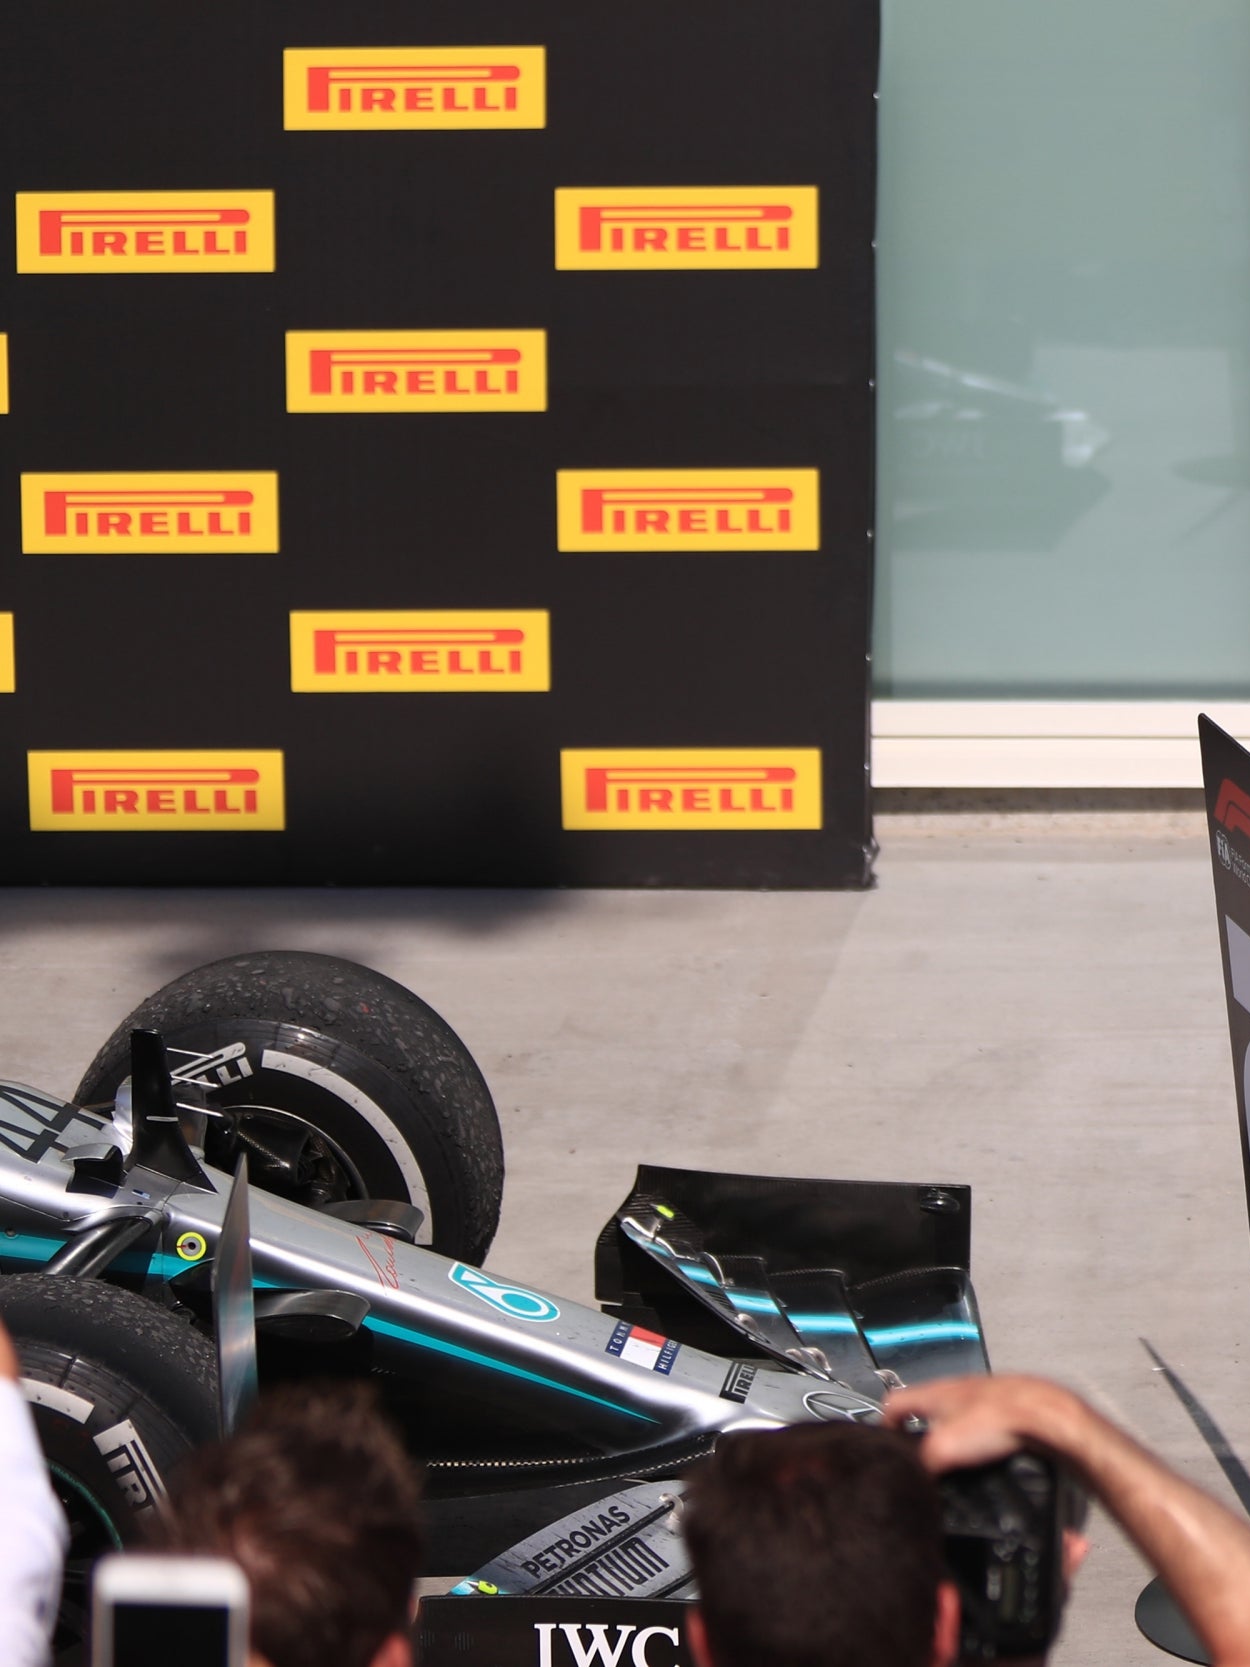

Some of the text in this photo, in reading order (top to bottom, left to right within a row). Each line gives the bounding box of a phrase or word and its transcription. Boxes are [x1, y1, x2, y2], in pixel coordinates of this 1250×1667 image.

[307, 66, 520, 112] PIRELLI
[38, 210, 250, 256] PIRELLI
[579, 206, 793, 252] PIRELLI
[310, 350, 521, 395] PIRELLI
[44, 491, 254, 537] PIRELLI
[581, 489, 793, 534] PIRELLI
[314, 630, 524, 675] PIRELLI
[50, 769, 260, 814] PIRELLI
[585, 768, 796, 813] PIRELLI
[520, 1505, 631, 1579] PETRONAS
[534, 1623, 680, 1667] IWC
